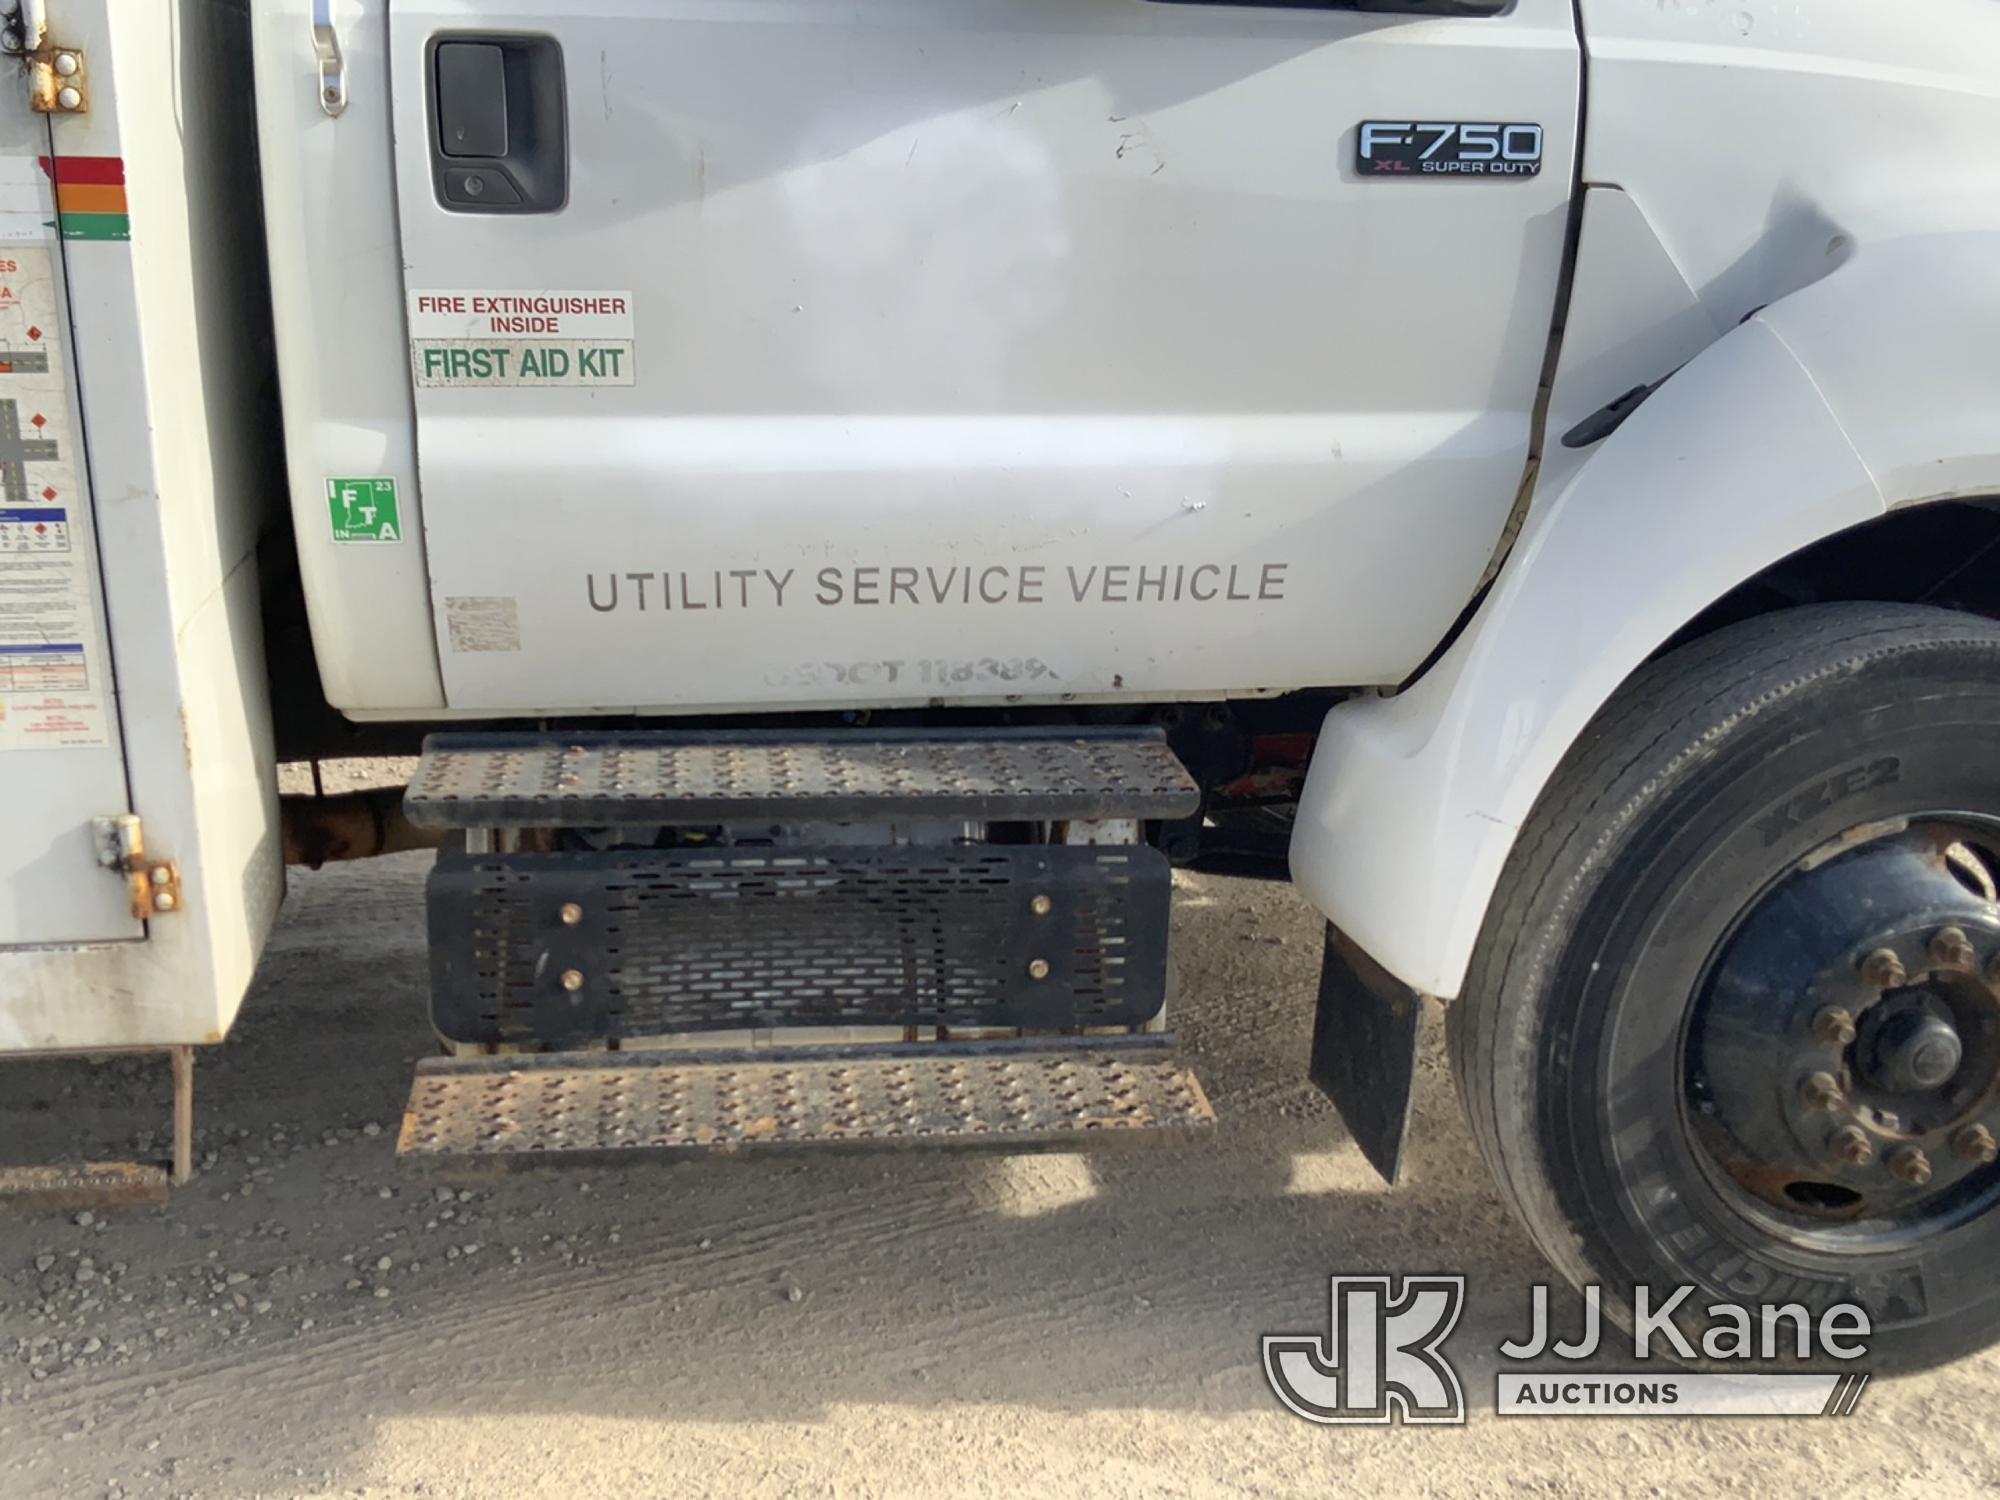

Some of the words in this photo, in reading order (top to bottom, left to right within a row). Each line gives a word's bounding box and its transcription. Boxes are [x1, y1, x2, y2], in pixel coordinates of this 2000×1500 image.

[1374, 160, 1410, 170] XL
[1422, 162, 1483, 173] SUPER
[1489, 163, 1540, 173] DUTY
[418, 297, 466, 313] FIRE
[473, 297, 626, 315] EXTINGUISHER
[490, 317, 559, 333] INSIDE
[424, 349, 510, 378] FIRST
[519, 349, 569, 377] AID
[579, 349, 624, 377] KIT
[375, 481, 393, 491] 23
[335, 529, 350, 539] IN
[587, 569, 794, 612] UTILITY
[815, 566, 1045, 606] SERVICE
[1066, 563, 1288, 602] VEHICLE
